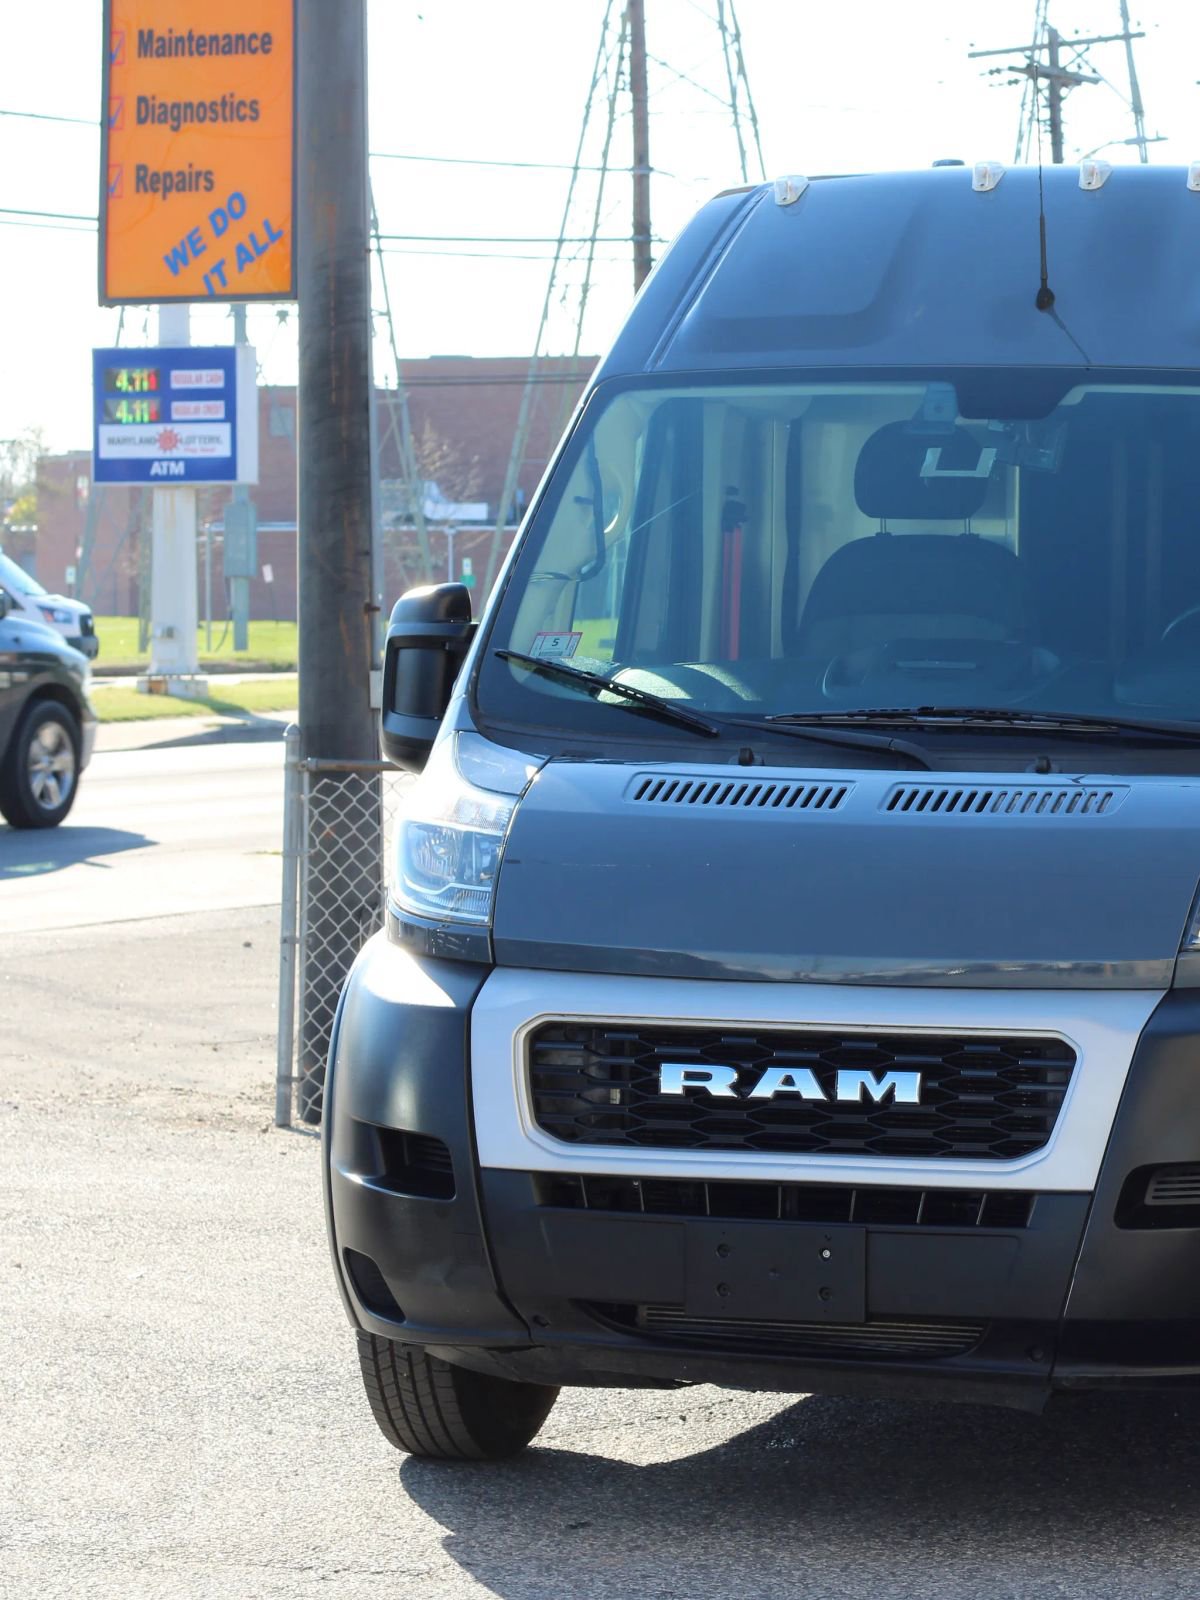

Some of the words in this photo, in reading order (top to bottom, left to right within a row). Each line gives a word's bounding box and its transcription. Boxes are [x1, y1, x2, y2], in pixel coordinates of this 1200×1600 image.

[137, 28, 273, 59] Maintenance
[136, 93, 260, 132] Diagnostics
[135, 163, 214, 201] Repairs
[163, 227, 207, 277] WE
[208, 192, 247, 238] DO
[202, 259, 228, 297] IT
[234, 219, 284, 273] ALL
[150, 461, 185, 476] ATM
[659, 1063, 921, 1104] RAM
